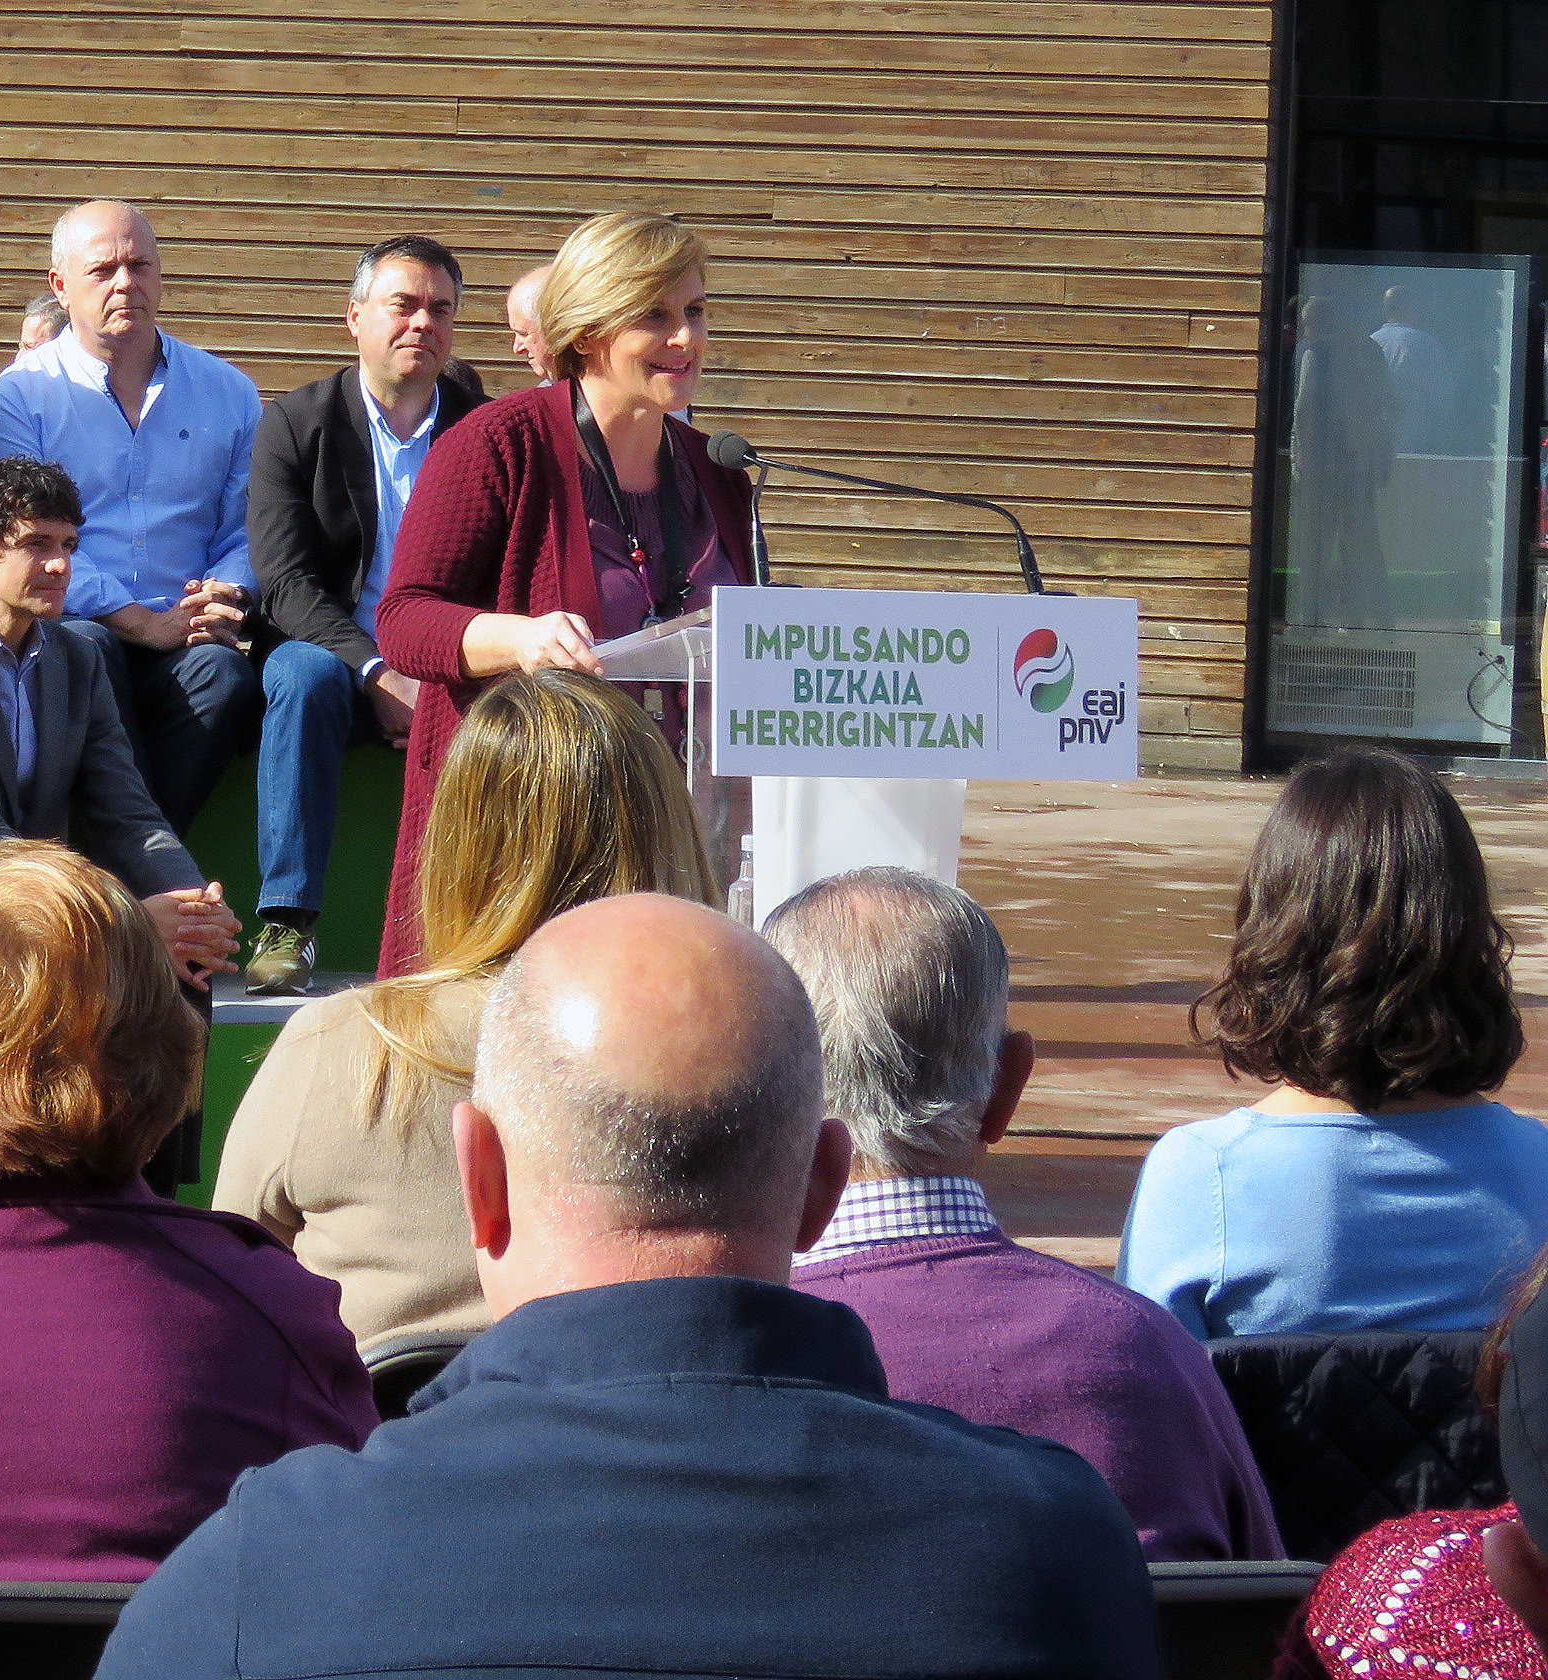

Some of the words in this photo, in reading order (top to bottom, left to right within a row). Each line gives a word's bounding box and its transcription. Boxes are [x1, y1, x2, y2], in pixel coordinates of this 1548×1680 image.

[743, 622, 971, 665] IMPULSANDO
[792, 667, 924, 706] BIZKAIA
[1082, 681, 1126, 726] eaj
[729, 709, 984, 749] HERRIGINTZAN
[1058, 716, 1114, 753] pnv
